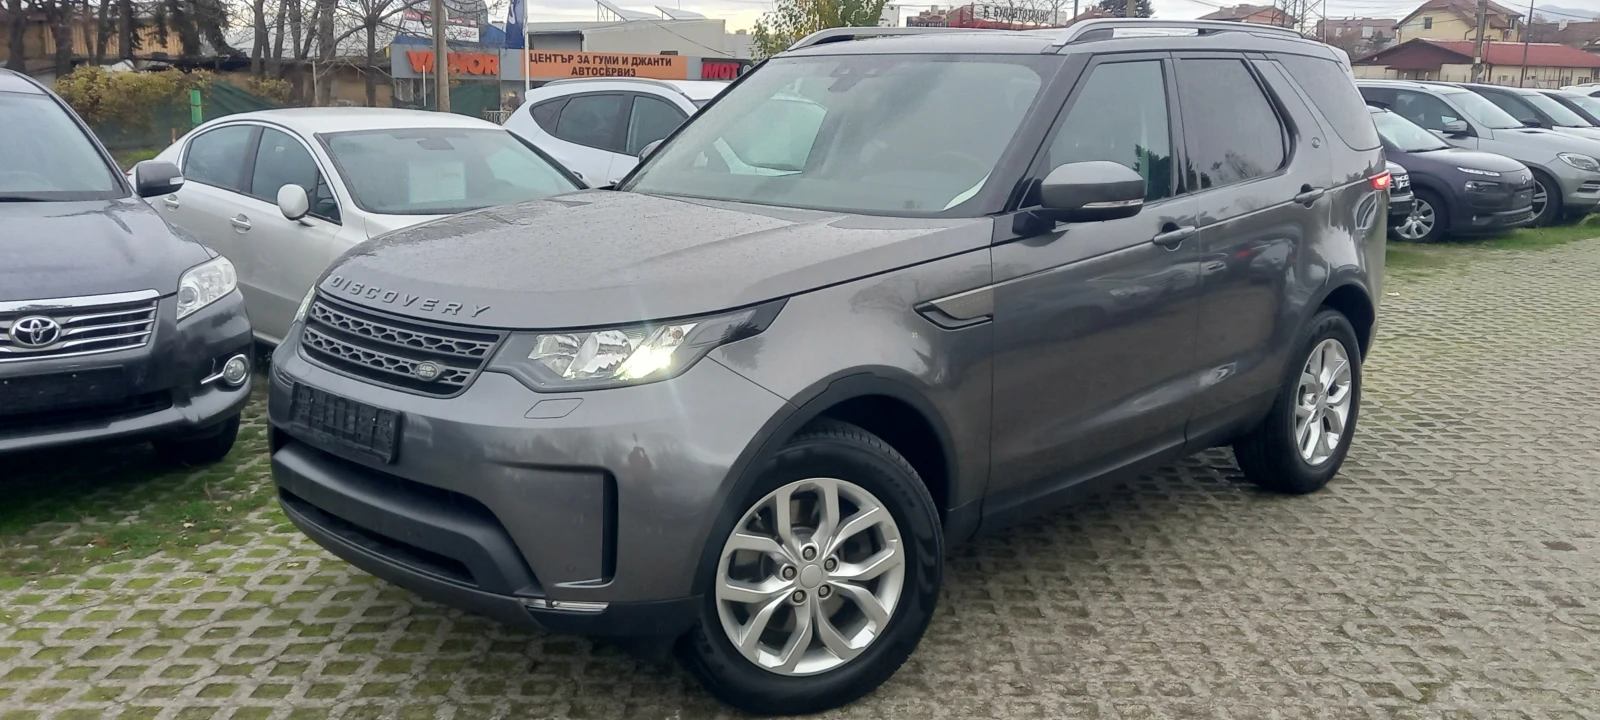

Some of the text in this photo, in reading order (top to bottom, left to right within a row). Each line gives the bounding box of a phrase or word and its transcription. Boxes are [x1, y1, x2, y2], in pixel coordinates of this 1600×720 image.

[407, 51, 499, 75] VINOR
[530, 53, 672, 67] ЦЕНТЪР ЗА ГУМИ И ДЖАНТИ
[571, 66, 636, 77] АВТОСЕРВИЗ
[331, 275, 491, 317] DISCOVERY
